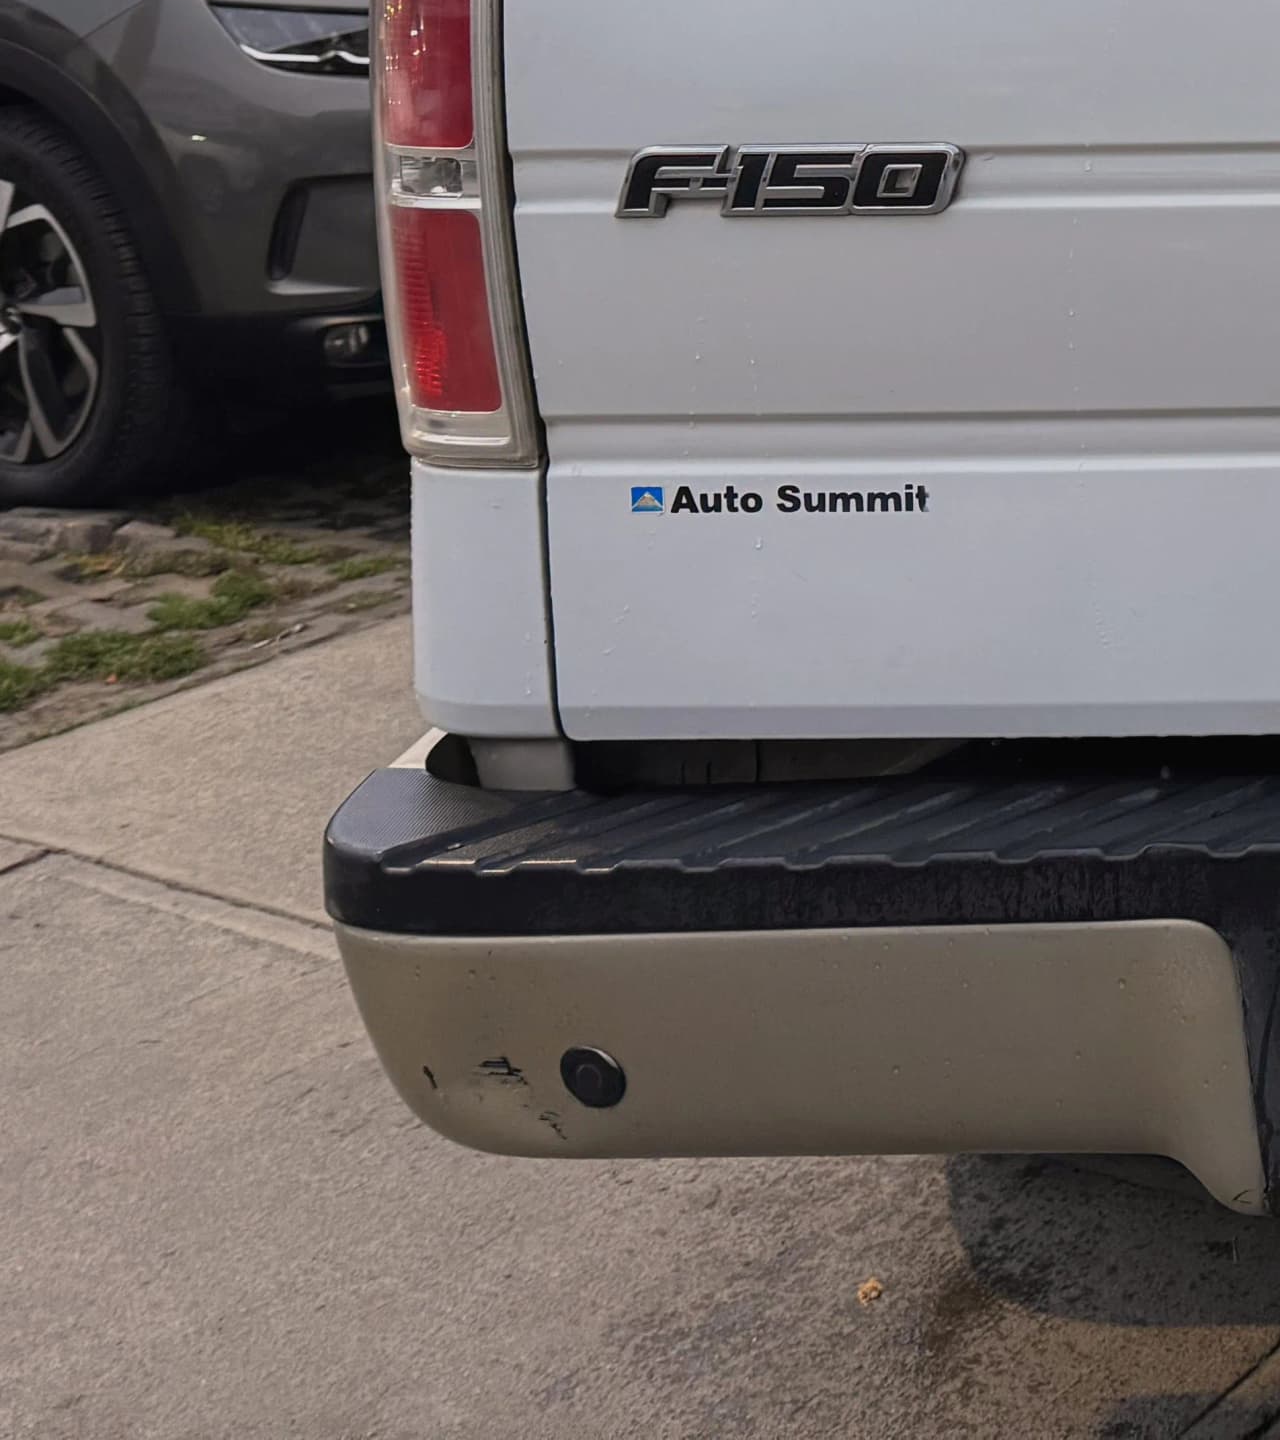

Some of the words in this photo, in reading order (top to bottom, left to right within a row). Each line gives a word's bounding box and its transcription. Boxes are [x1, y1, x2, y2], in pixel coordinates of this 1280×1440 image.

[614, 142, 966, 219] F-150
[670, 485, 764, 514] Auto
[776, 484, 930, 513] Summit
